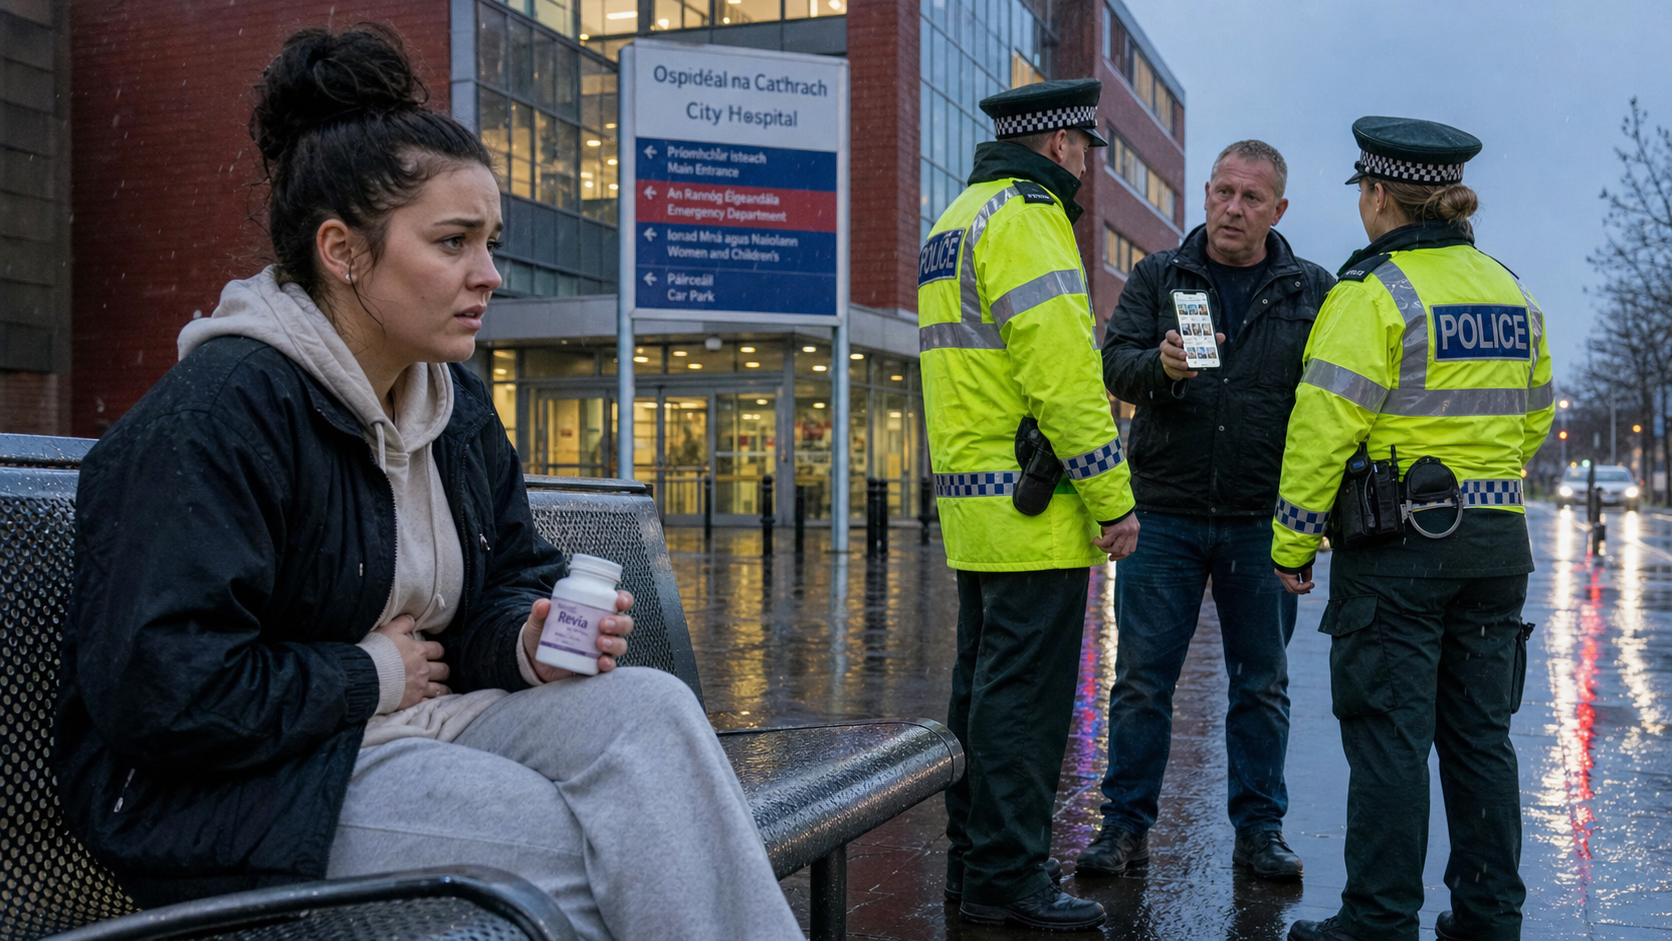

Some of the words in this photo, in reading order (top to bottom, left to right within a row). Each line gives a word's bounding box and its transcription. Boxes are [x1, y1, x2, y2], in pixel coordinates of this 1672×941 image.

[653, 65, 728, 89] Ospidéal
[731, 75, 751, 90] na
[686, 101, 723, 126] City
[728, 104, 798, 129] Hospital
[667, 161, 694, 175] Main
[695, 163, 740, 178] Entrance
[667, 187, 683, 199] An
[684, 187, 723, 205] Rannóg
[667, 203, 725, 221] Emergency
[727, 207, 787, 222] Department
[667, 228, 698, 242] Ionad
[699, 230, 723, 244] Mná
[724, 234, 750, 247] agus
[667, 245, 708, 259] Women
[709, 247, 730, 260] and
[919, 236, 960, 278] POLICE
[667, 288, 688, 302] Car
[689, 289, 716, 303] Park
[1439, 312, 1528, 350] POLICE
